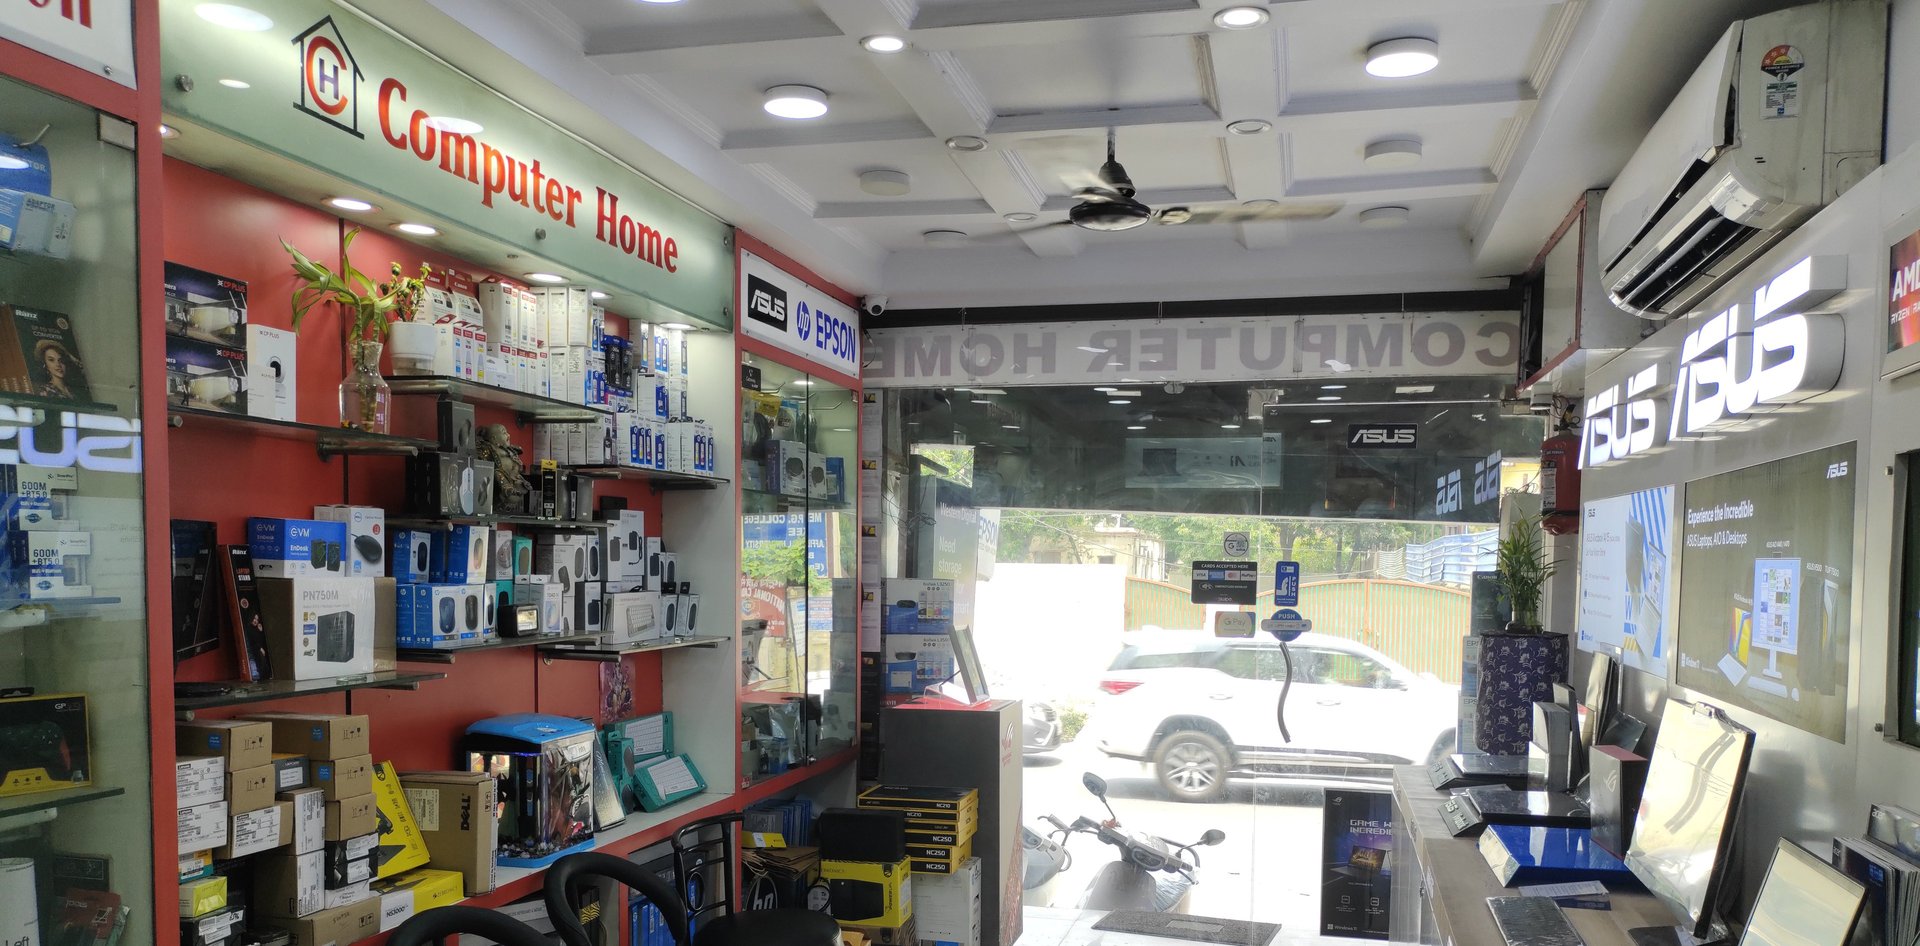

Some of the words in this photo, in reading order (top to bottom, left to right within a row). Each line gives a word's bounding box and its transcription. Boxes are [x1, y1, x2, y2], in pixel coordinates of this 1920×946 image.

[378, 77, 582, 228] Computer
[595, 185, 678, 274] Home
[232, 283, 246, 292] PLUS
[751, 289, 785, 321] ASUS
[797, 301, 811, 341] hp
[816, 309, 855, 363] EPSON
[231, 352, 245, 361] PLUS
[1669, 255, 1811, 441] ASUS
[1577, 363, 1657, 470] ASUS
[1351, 429, 1415, 443] ASUS
[1827, 462, 1848, 478] ASUS
[22, 481, 47, 490] 600M
[940, 502, 960, 518] Western
[961, 508, 976, 525] Digital
[1688, 507, 1714, 528] Experience
[1714, 505, 1723, 521] the
[1724, 500, 1753, 519] Incredible
[940, 536, 956, 553] Need
[1726, 531, 1747, 548] Desktops
[33, 549, 58, 558] 600M
[938, 560, 962, 577] storage
[303, 590, 339, 601] PN750M
[461, 793, 471, 831] DELL
[1350, 819, 1378, 828] GAME
